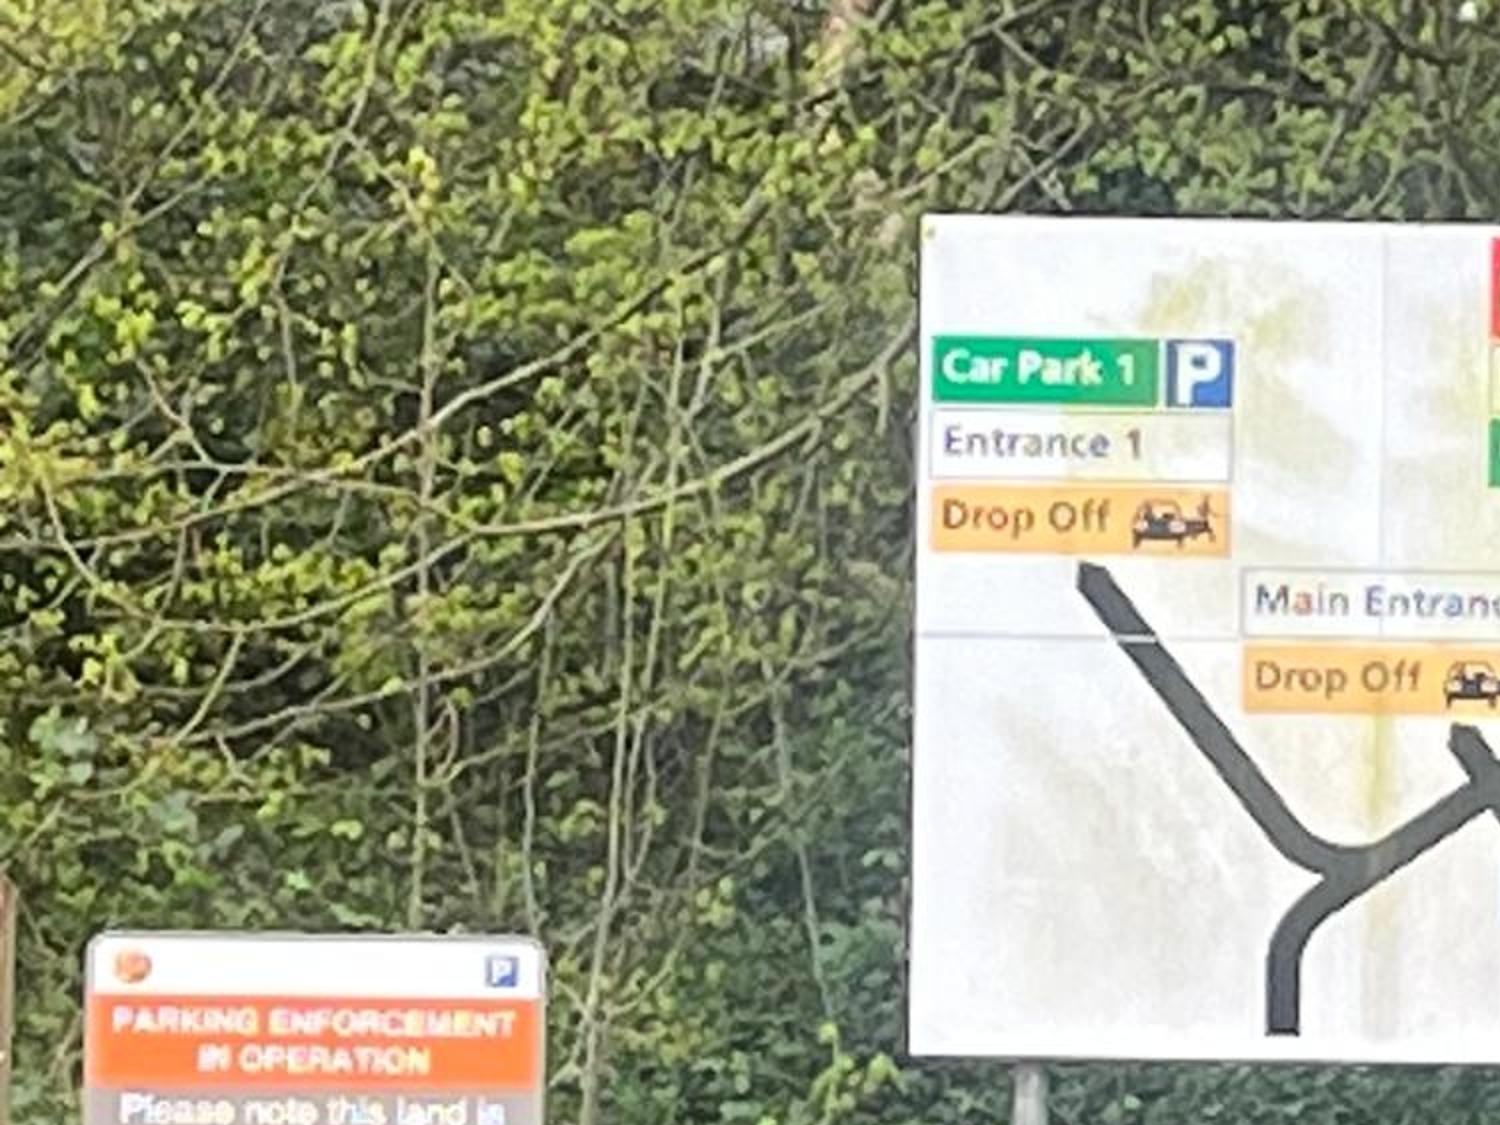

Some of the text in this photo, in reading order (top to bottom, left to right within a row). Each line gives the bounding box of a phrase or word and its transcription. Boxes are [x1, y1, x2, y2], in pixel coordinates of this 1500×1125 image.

[942, 348, 1134, 386] Car Park 1
[1175, 343, 1222, 406] P
[943, 425, 1142, 459] Entrance 1
[942, 498, 1112, 539] Drop Off
[1255, 583, 1350, 616] Main
[1255, 659, 1422, 700] Drop Off
[112, 1008, 517, 1038] PARKING ENFORCEMENT
[199, 1047, 431, 1074] IN OPERATION
[119, 1094, 234, 1125] Please
